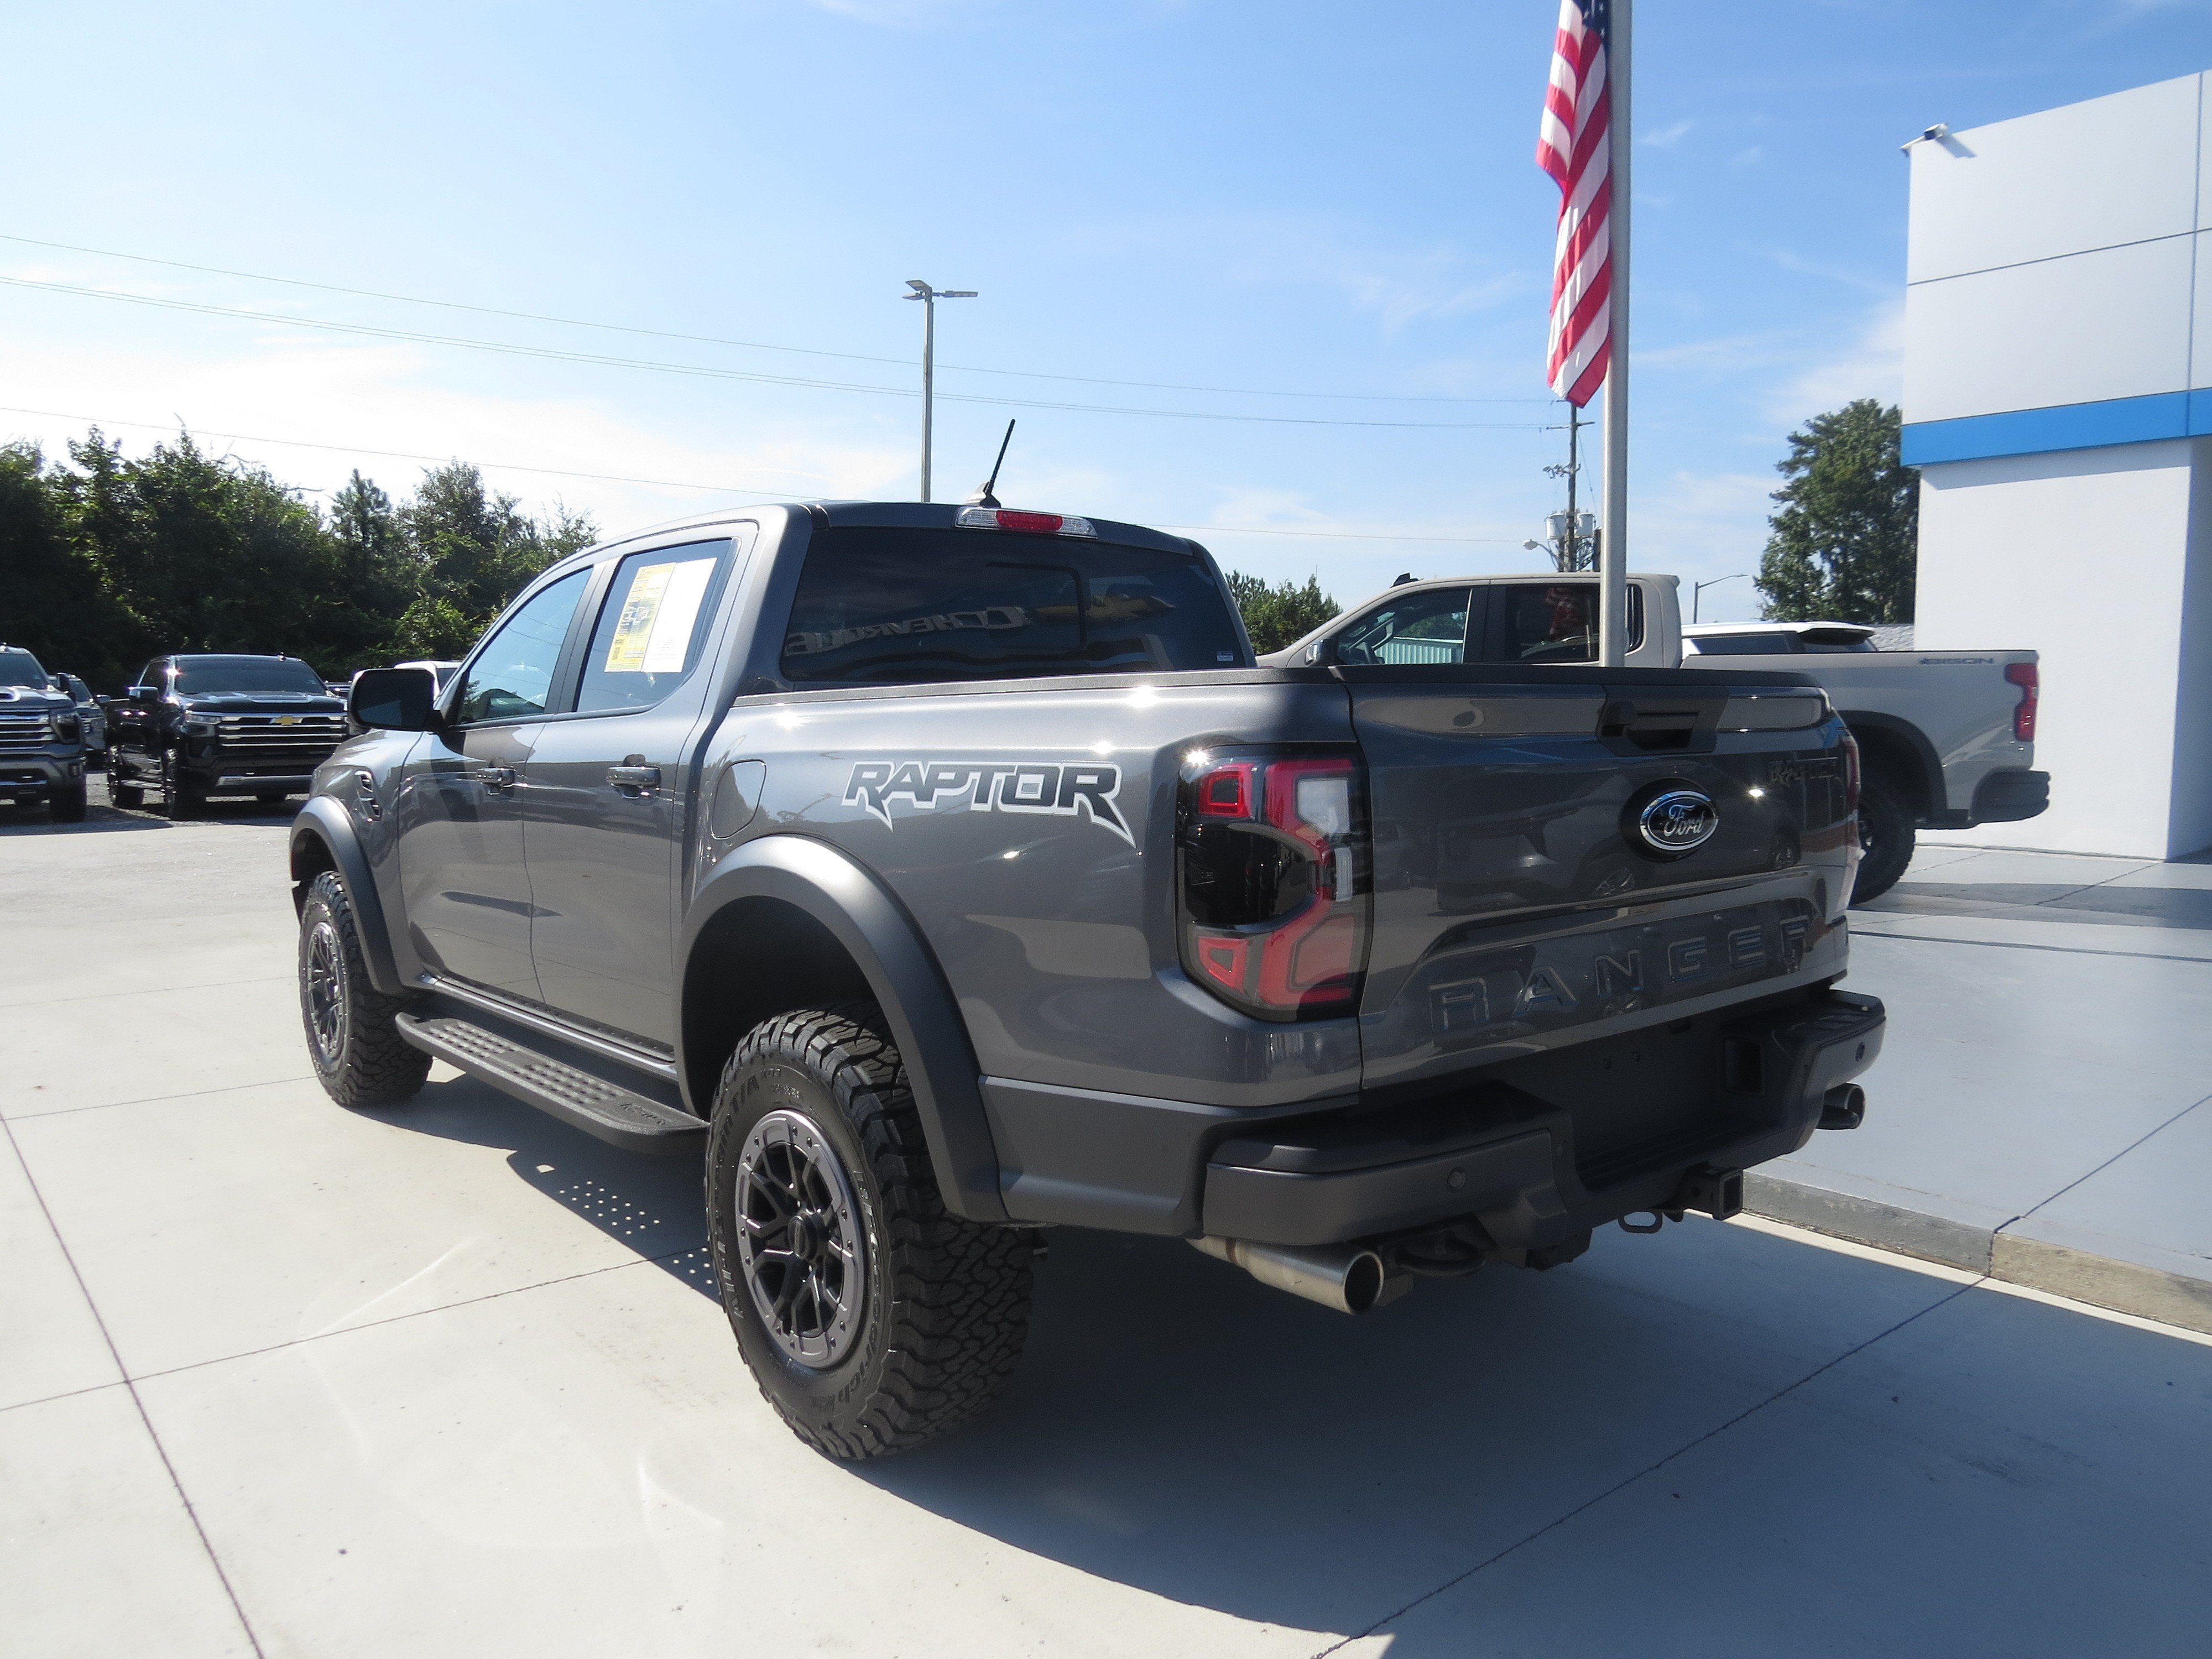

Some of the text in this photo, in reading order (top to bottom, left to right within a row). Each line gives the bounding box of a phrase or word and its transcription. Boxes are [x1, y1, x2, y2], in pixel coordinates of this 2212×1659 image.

[842, 761, 1136, 848] RAPTOR
[1663, 804, 1705, 837] Ford
[1428, 915, 1809, 1031] RANGER
